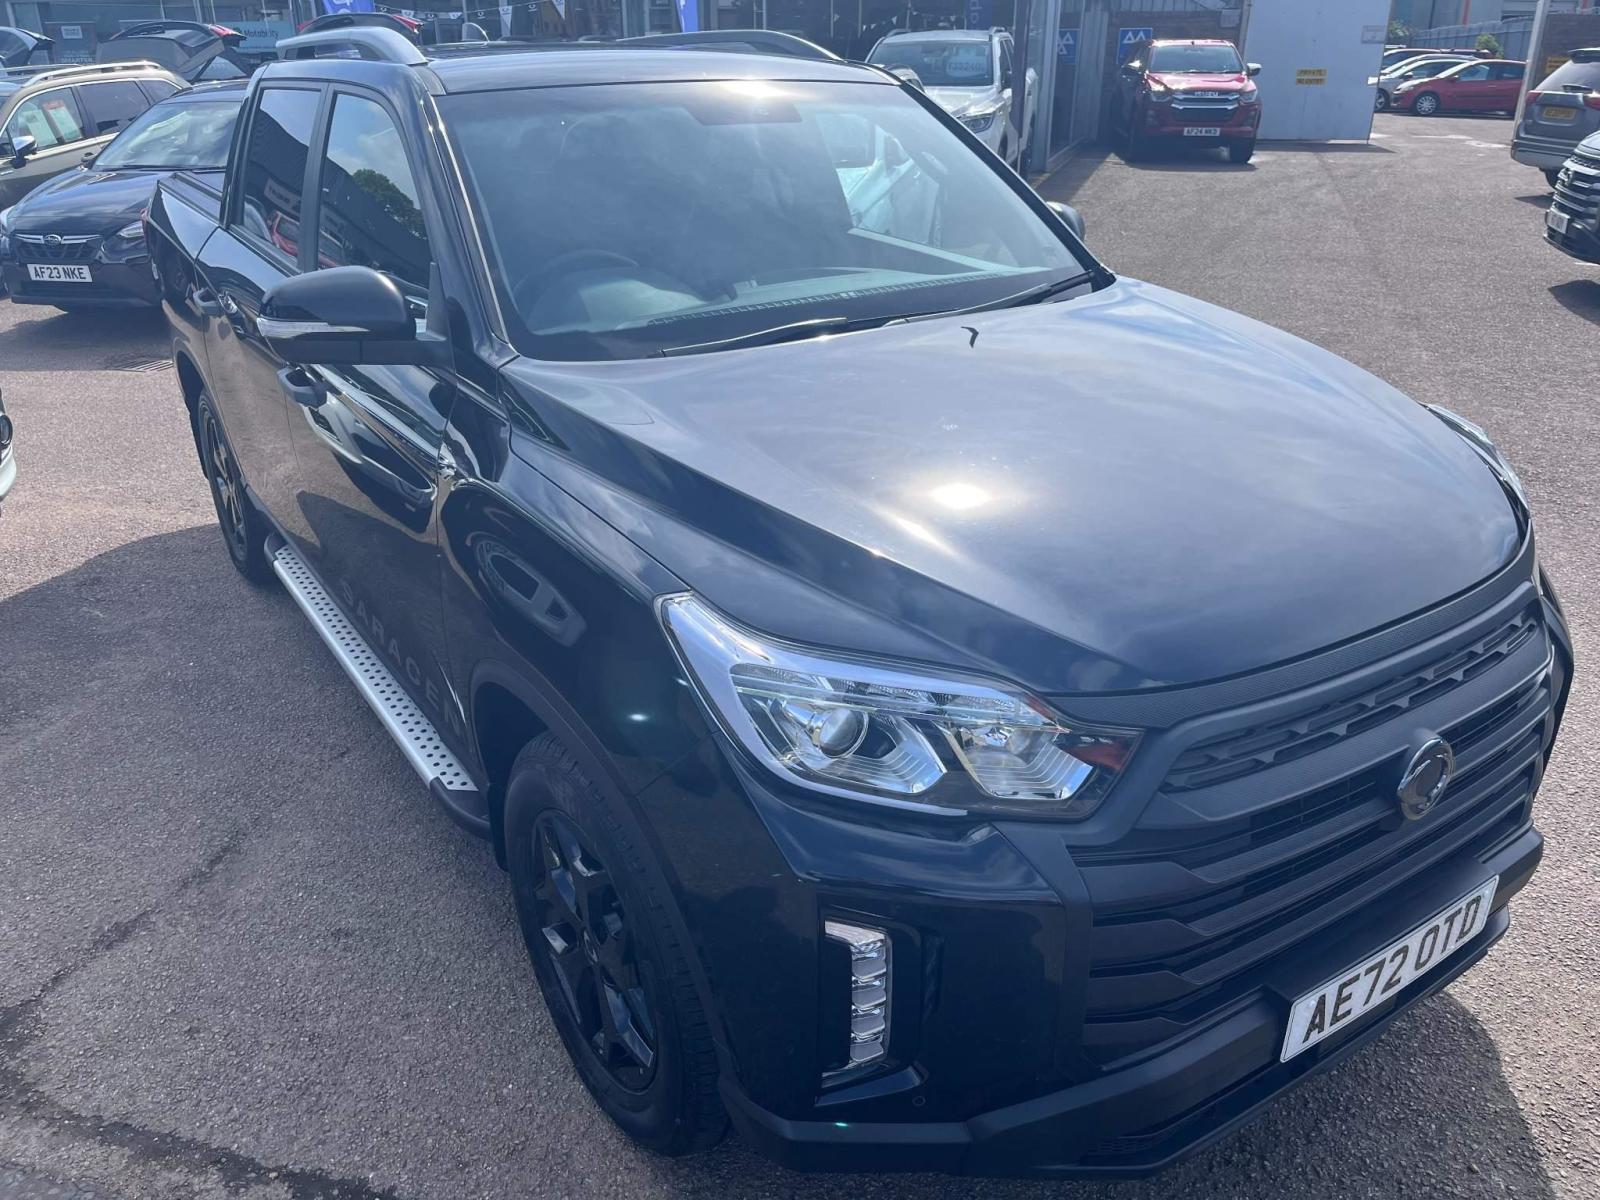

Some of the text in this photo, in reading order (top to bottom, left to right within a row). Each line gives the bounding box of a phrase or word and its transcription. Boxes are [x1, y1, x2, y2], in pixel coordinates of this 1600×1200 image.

[34, 266, 86, 280] AF23 NKE
[339, 577, 461, 736] SARACEN
[1303, 895, 1482, 1044] AE72 OTD
